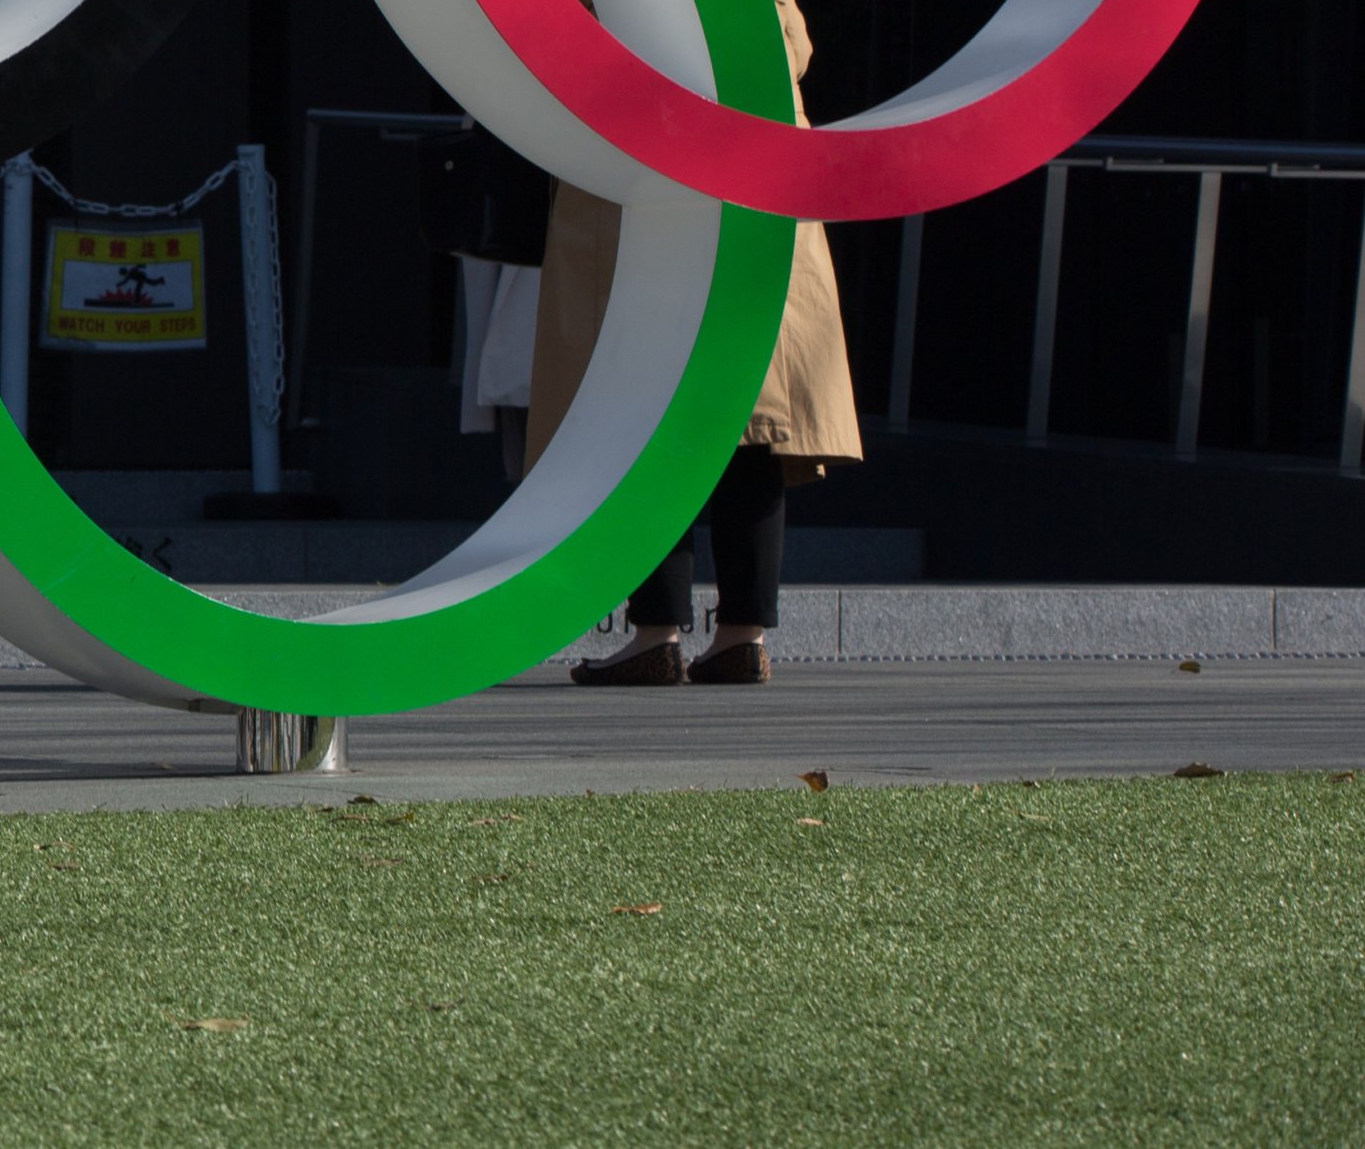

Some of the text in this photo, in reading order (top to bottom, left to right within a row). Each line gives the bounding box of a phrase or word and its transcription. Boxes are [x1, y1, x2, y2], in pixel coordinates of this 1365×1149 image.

[59, 316, 196, 334] WATCH YOUR STEPS
